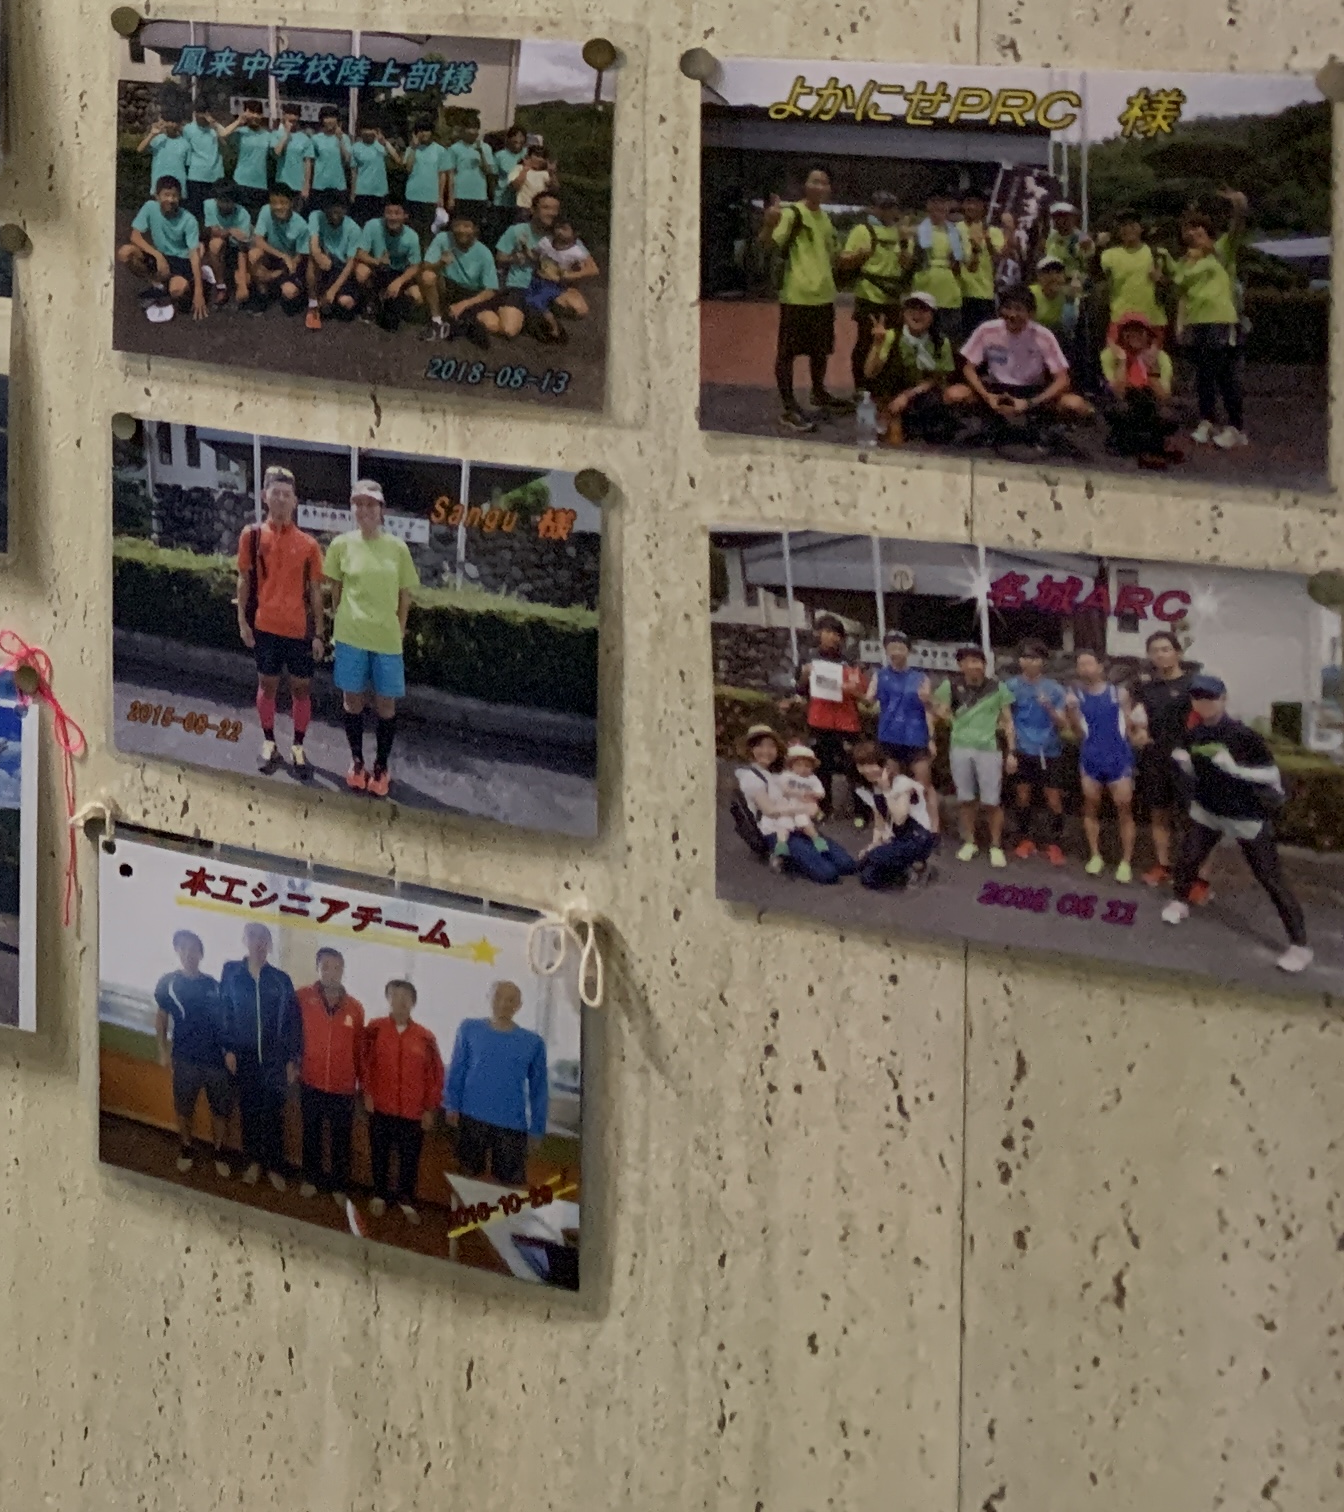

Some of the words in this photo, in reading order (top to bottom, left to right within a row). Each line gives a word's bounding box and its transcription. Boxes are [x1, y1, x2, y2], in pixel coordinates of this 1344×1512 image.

[768, 74, 1082, 131] よかにせPRC
[1118, 86, 1187, 138] 様
[426, 356, 573, 395] 2018-08-13
[430, 495, 520, 533] Sangu
